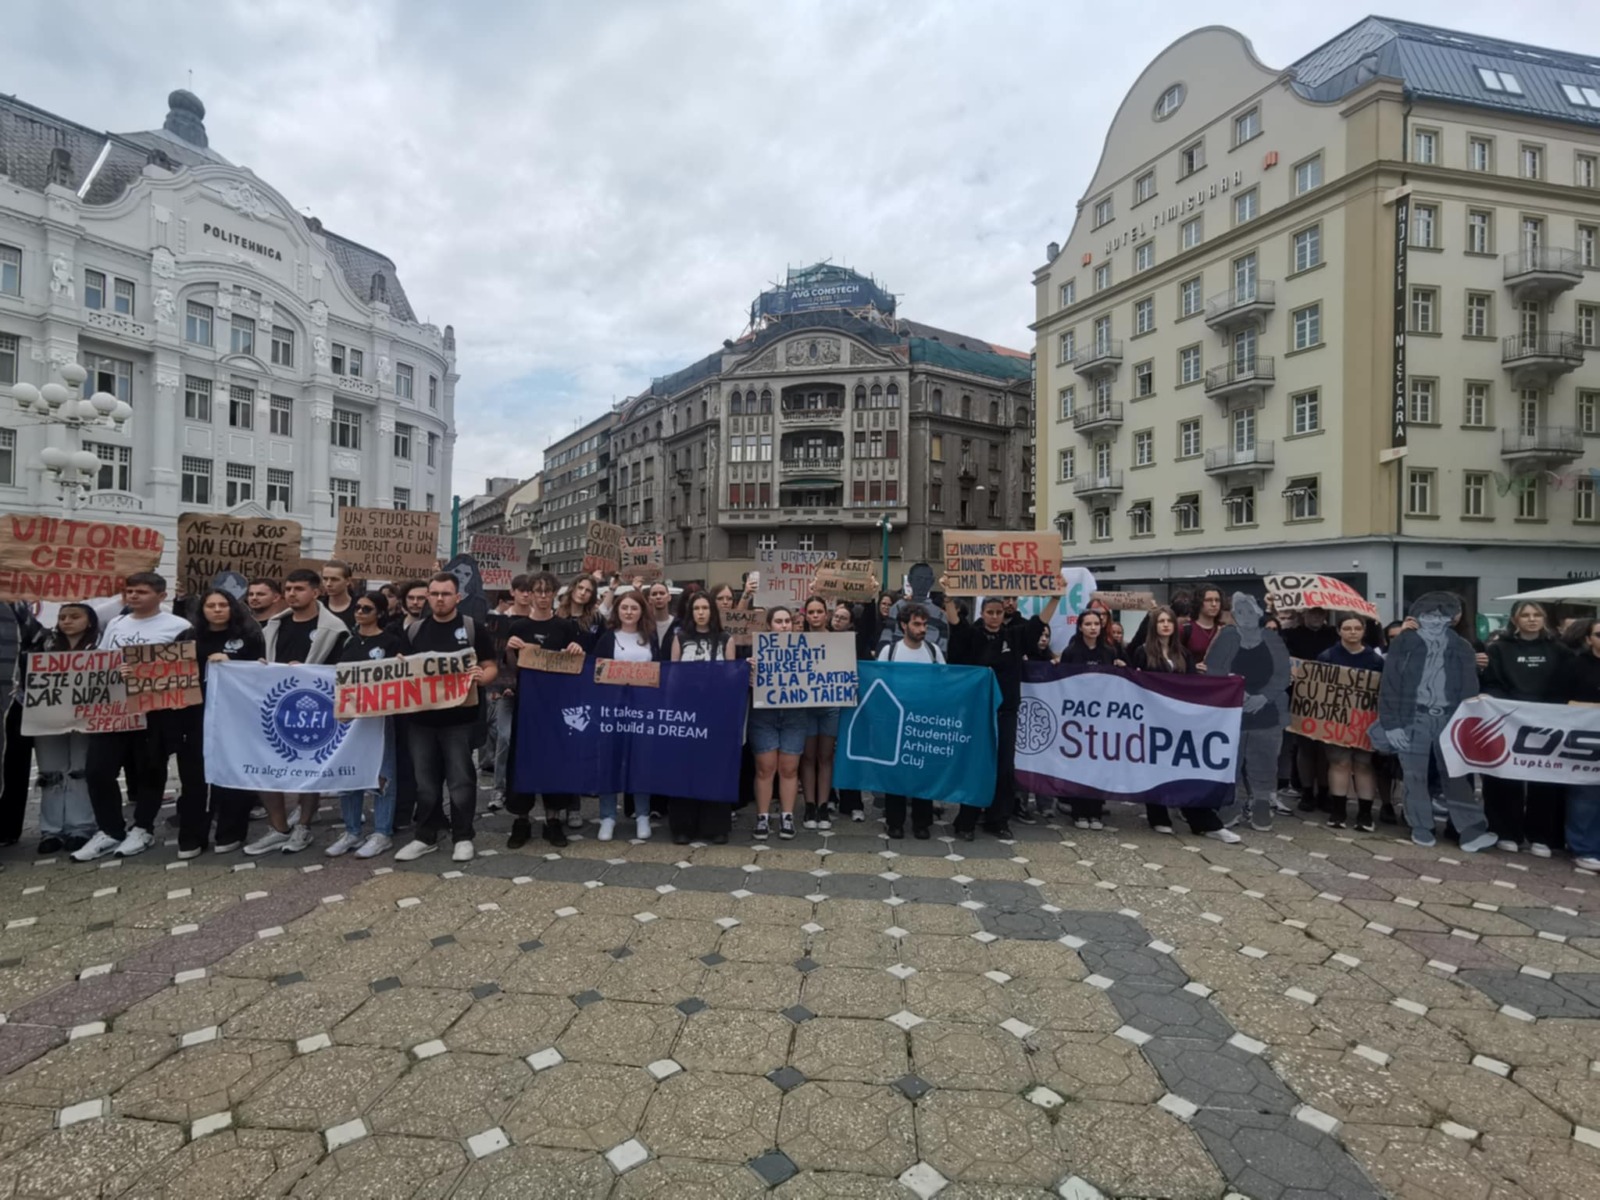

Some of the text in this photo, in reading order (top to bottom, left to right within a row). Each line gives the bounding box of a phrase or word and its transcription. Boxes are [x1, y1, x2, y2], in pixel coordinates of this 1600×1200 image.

[203, 223, 282, 261] POLITEHNICA
[1105, 222, 1146, 255] HOTEL
[1397, 205, 1407, 290] HOTEL
[791, 290, 810, 300] AVG
[811, 285, 860, 297] CONSTECH
[344, 511, 431, 527] UN STUDENT
[12, 516, 162, 553] VIITORUL
[253, 524, 288, 539] SCOS
[407, 529, 414, 539] E
[418, 531, 434, 542] UN
[187, 535, 215, 555] DIN
[341, 539, 432, 555] STUDENT CU UN
[625, 535, 657, 548] VREM
[960, 541, 1038, 560] IANUARIE CFR
[31, 545, 117, 571] CERE
[364, 552, 403, 565] PICIOR
[633, 554, 648, 565] NU
[760, 551, 773, 562] CE
[375, 564, 393, 575] DIN
[961, 557, 1053, 575] IUNIE BURSELE
[1204, 567, 1256, 576] STARBUCKS
[961, 574, 977, 589] MAI
[1269, 575, 1318, 591] 10%
[758, 633, 808, 649] DE LA
[122, 643, 193, 665] BURSE
[336, 653, 473, 686] VIITORUL CERE
[757, 670, 858, 687] DE LA PARTIDE
[1297, 661, 1345, 687] STATUL
[27, 672, 69, 689] ESTE
[75, 673, 83, 686] O
[125, 674, 201, 696] BAGAJE
[1295, 680, 1318, 699] CU
[26, 690, 62, 708] DAR
[600, 705, 697, 723] It takes a TEAM
[1061, 699, 1144, 721] PAC PAC
[905, 711, 963, 729] Asociația
[1301, 717, 1317, 734] O
[600, 721, 708, 740] to build a DREAM
[904, 725, 972, 744] Studenților
[902, 740, 955, 758] Arhitecți
[1059, 719, 1231, 770] StudPAC
[900, 753, 925, 769] Cluj
[242, 764, 259, 775] Tu
[261, 765, 288, 779] alegi
[290, 768, 303, 777] ce
[338, 765, 356, 776] fii!
